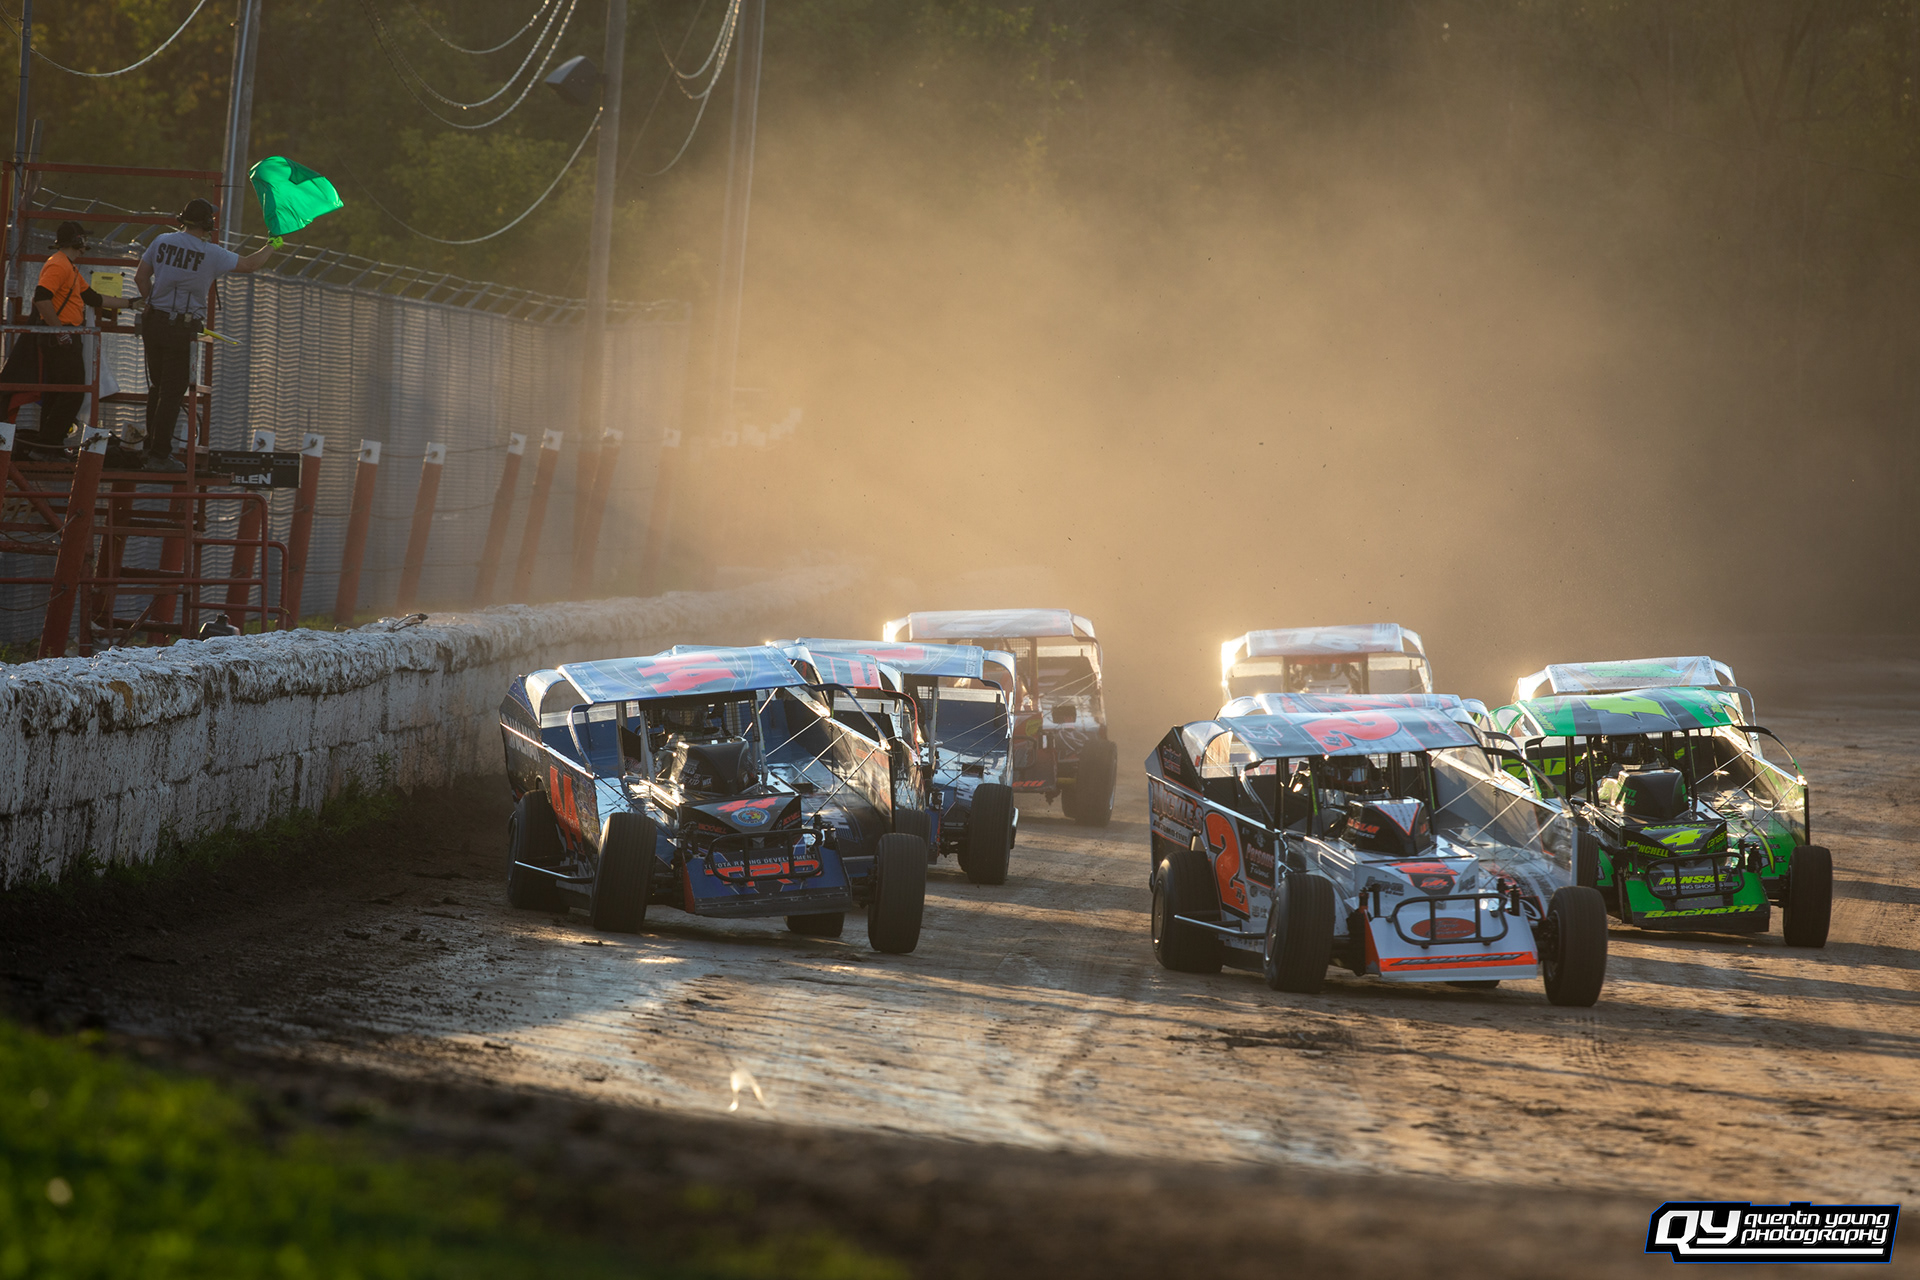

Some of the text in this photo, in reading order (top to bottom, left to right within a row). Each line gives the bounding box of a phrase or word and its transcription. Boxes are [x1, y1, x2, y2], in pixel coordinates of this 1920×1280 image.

[156, 243, 205, 271] STAFF
[232, 473, 272, 485] ELEN
[1661, 828, 1702, 846] 4
[734, 858, 762, 867] RAING
[764, 853, 817, 864] DEVELMENT
[1205, 812, 1250, 914] 2
[1644, 903, 1759, 919] Bachetti
